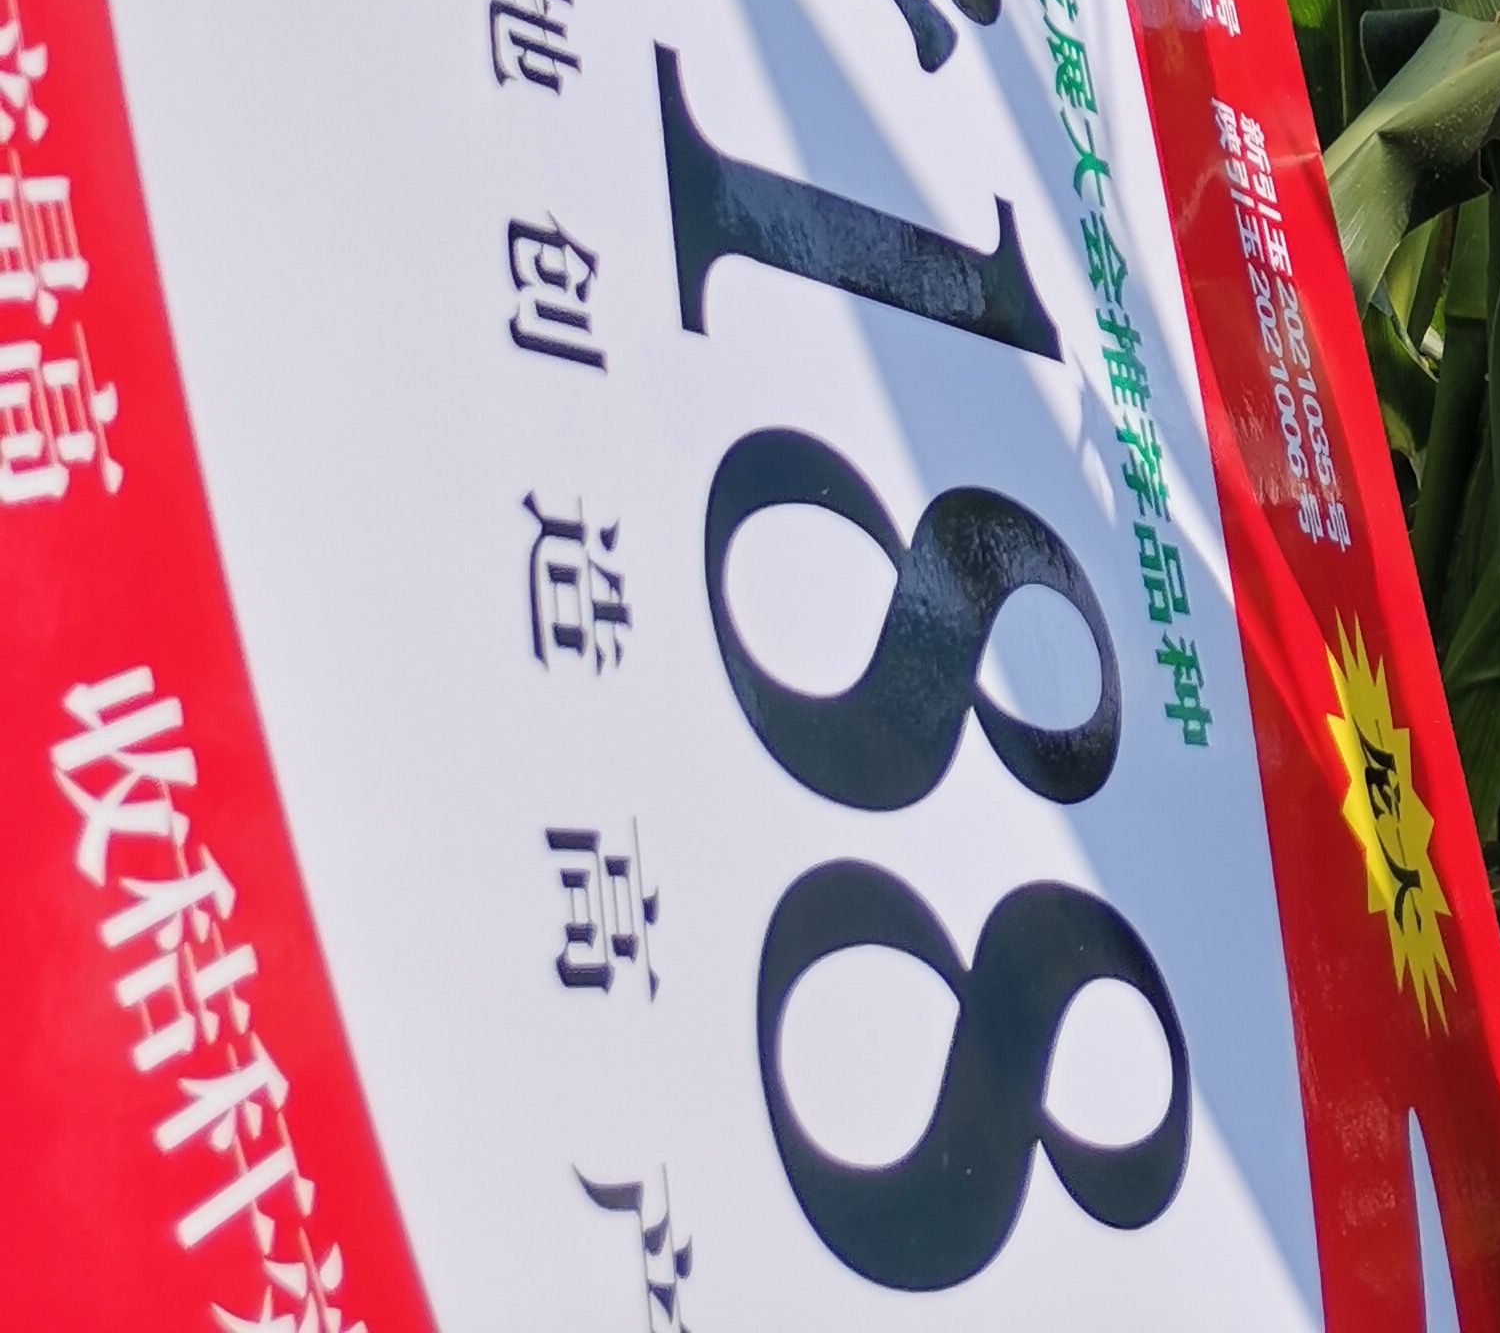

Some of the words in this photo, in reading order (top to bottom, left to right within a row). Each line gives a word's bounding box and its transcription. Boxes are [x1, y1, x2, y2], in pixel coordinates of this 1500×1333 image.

[1209, 96, 1323, 544] 陕引玉2021006号
[1237, 112, 1352, 552] 新引玉2021035号
